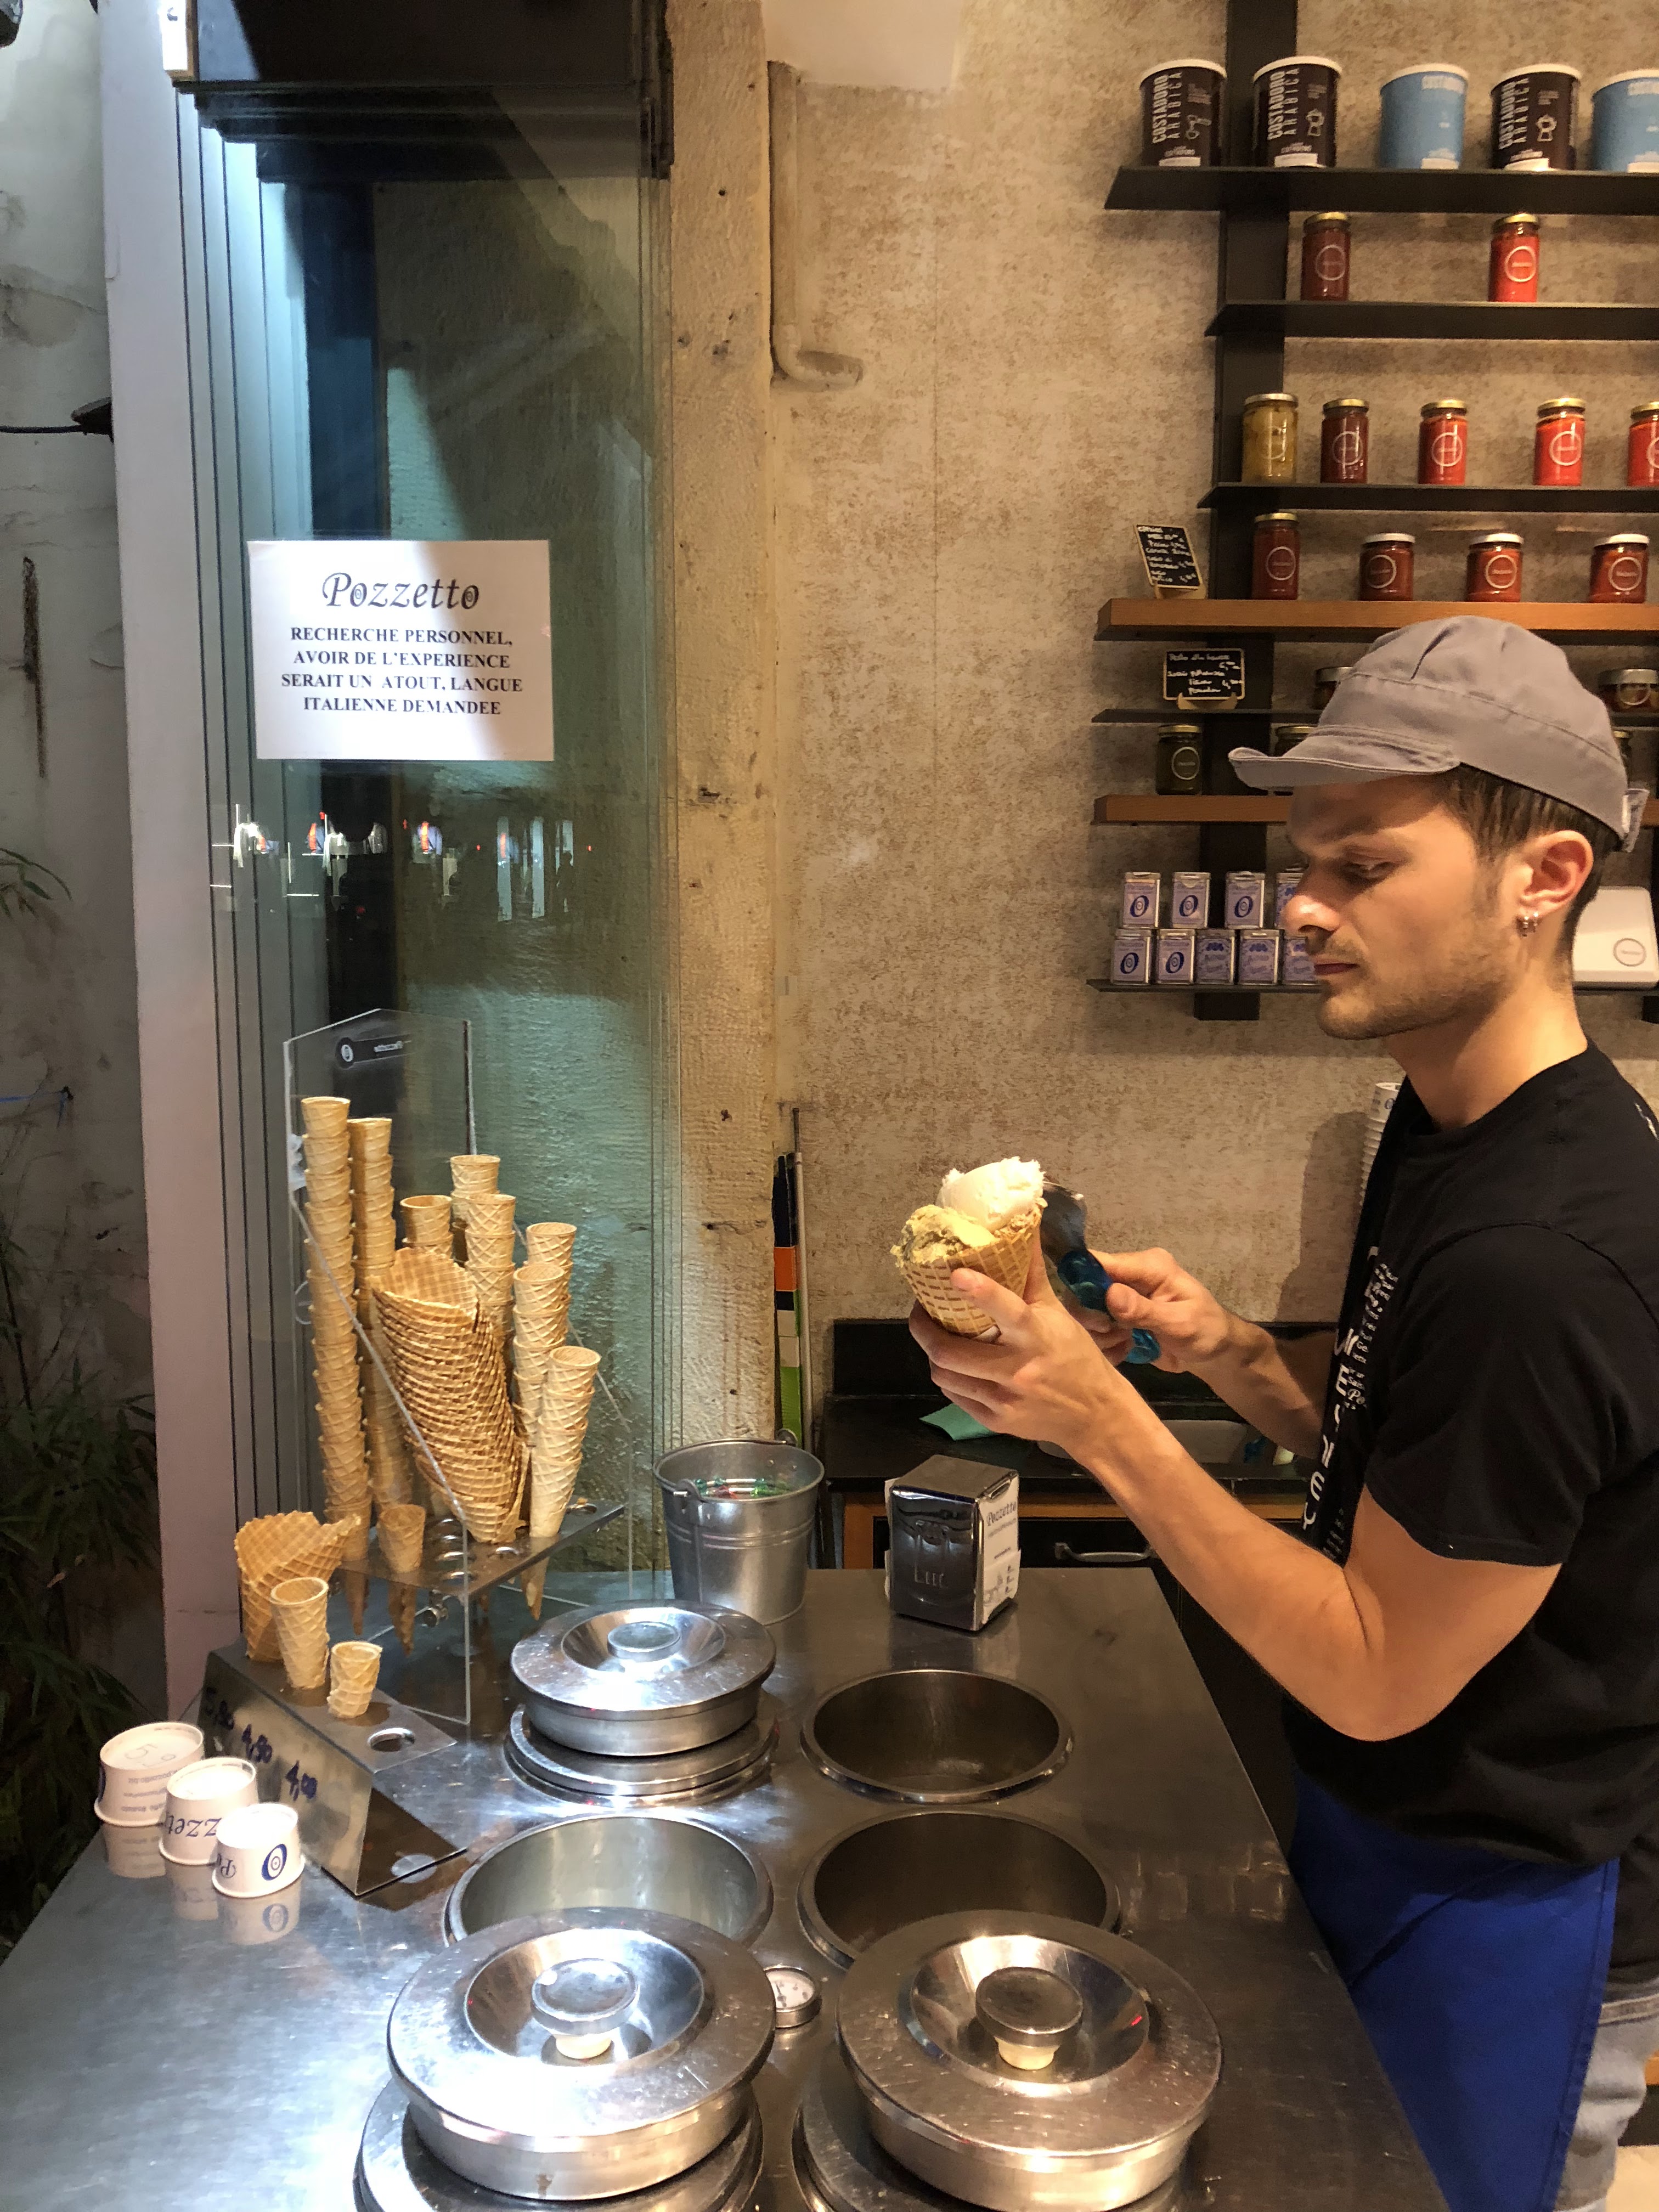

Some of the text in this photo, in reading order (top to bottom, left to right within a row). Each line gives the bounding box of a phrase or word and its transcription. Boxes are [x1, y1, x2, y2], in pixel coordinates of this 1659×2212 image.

[1167, 72, 1182, 139] ARABICA
[1284, 68, 1299, 135] ARABICA
[322, 572, 479, 609] Pozzetto
[290, 627, 512, 646] RECHERCHE PERSONNEL,
[294, 651, 510, 668] AVOIR DE L'EXPERIENCE
[281, 674, 343, 687] SERAIT
[349, 675, 372, 687] UN
[450, 678, 523, 692] LANGUE
[303, 697, 501, 715] ITALIENNE DEMANDEE
